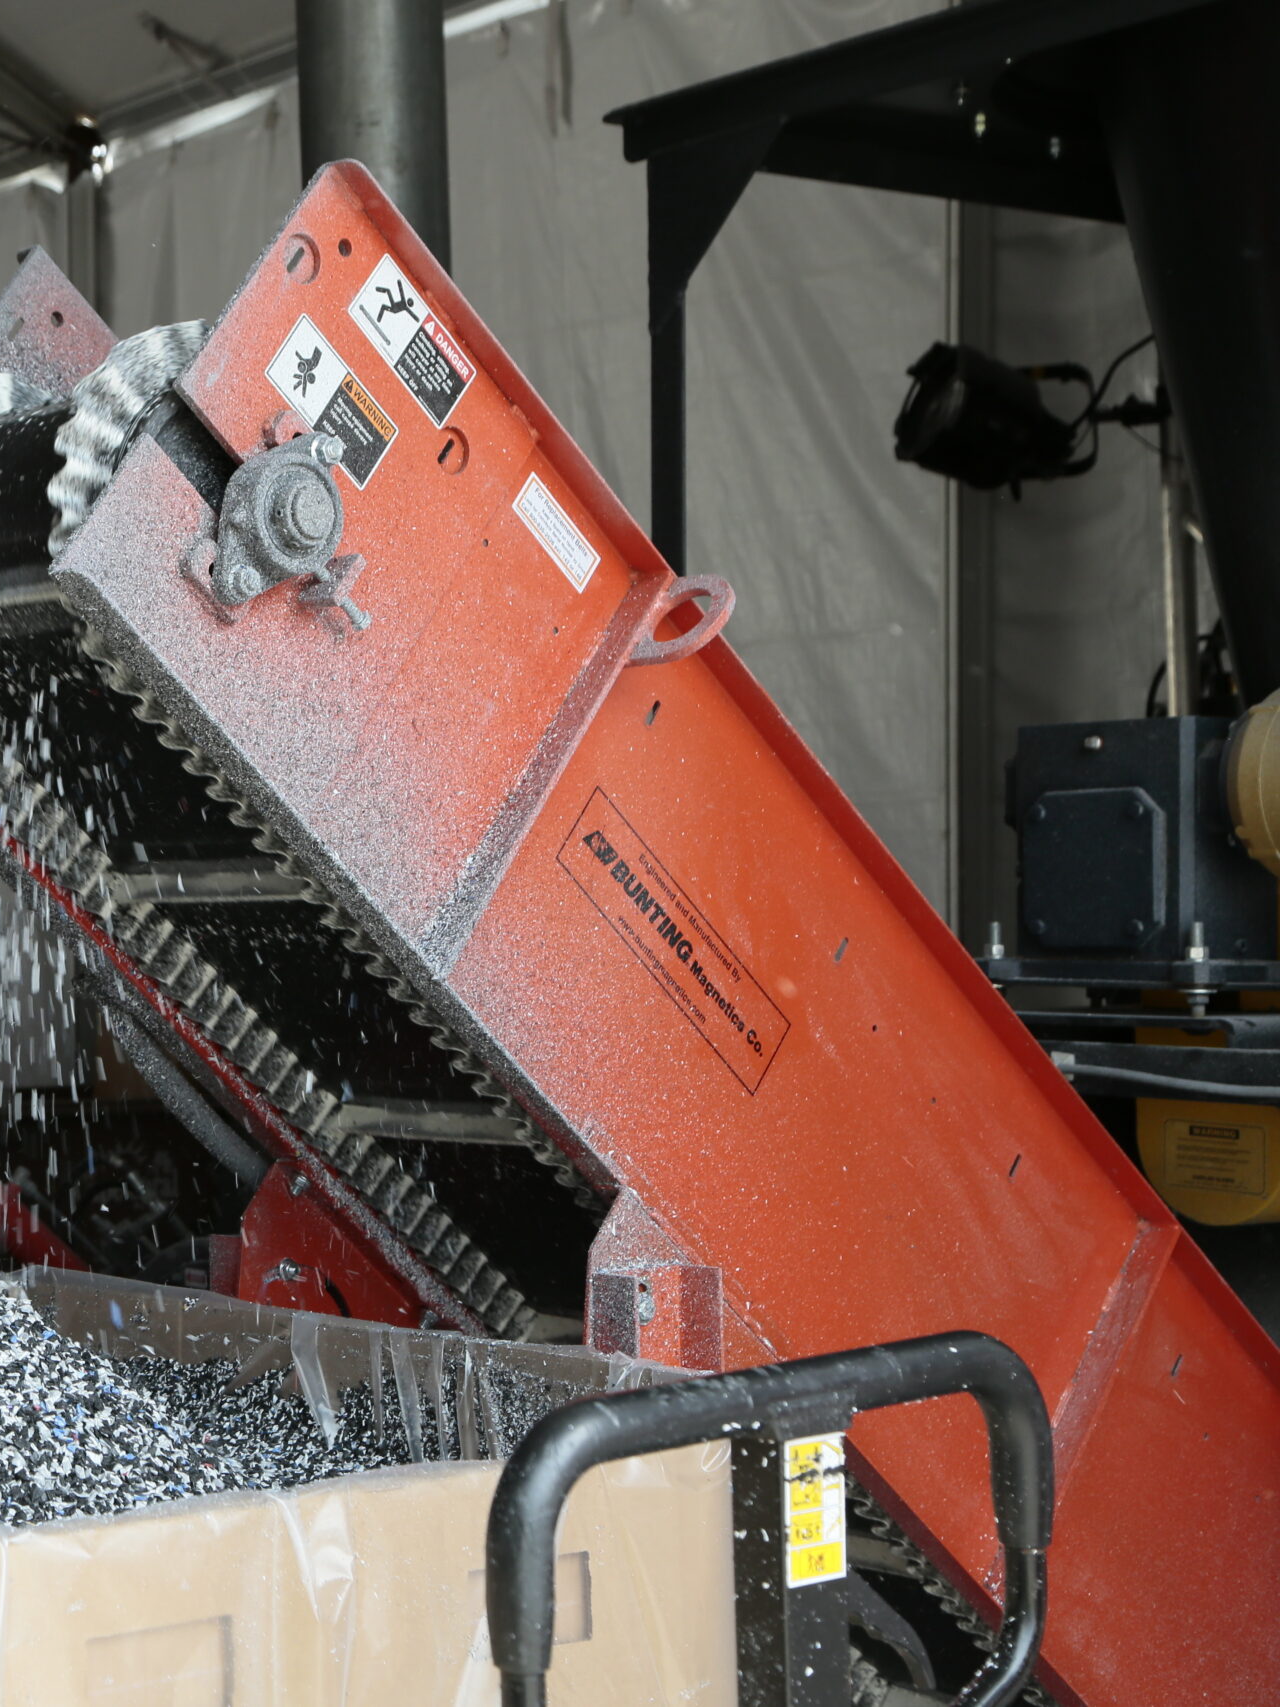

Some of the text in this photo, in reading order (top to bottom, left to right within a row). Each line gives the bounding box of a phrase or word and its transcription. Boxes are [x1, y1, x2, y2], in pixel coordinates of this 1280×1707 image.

[396, 362, 418, 392] KEEP OFF
[403, 352, 416, 370] injury
[415, 367, 421, 376] or
[407, 347, 416, 359] will
[414, 357, 427, 374] cause
[426, 373, 441, 392] severe
[410, 342, 451, 395] conveyor at any time
[414, 336, 453, 388] walking or riding on
[434, 331, 470, 379] DANGER
[322, 419, 335, 436] KEEP
[328, 408, 342, 426] injury
[332, 402, 342, 414] can
[340, 412, 354, 429] cause
[336, 396, 353, 417] Moving
[350, 414, 374, 443] equipment
[352, 387, 393, 436] WARNING
[534, 486, 588, 557] For Replacement Belts
[637, 852, 742, 984] Engineered and Manufactured By
[609, 855, 767, 1058] BUNTING Magnetics Co.
